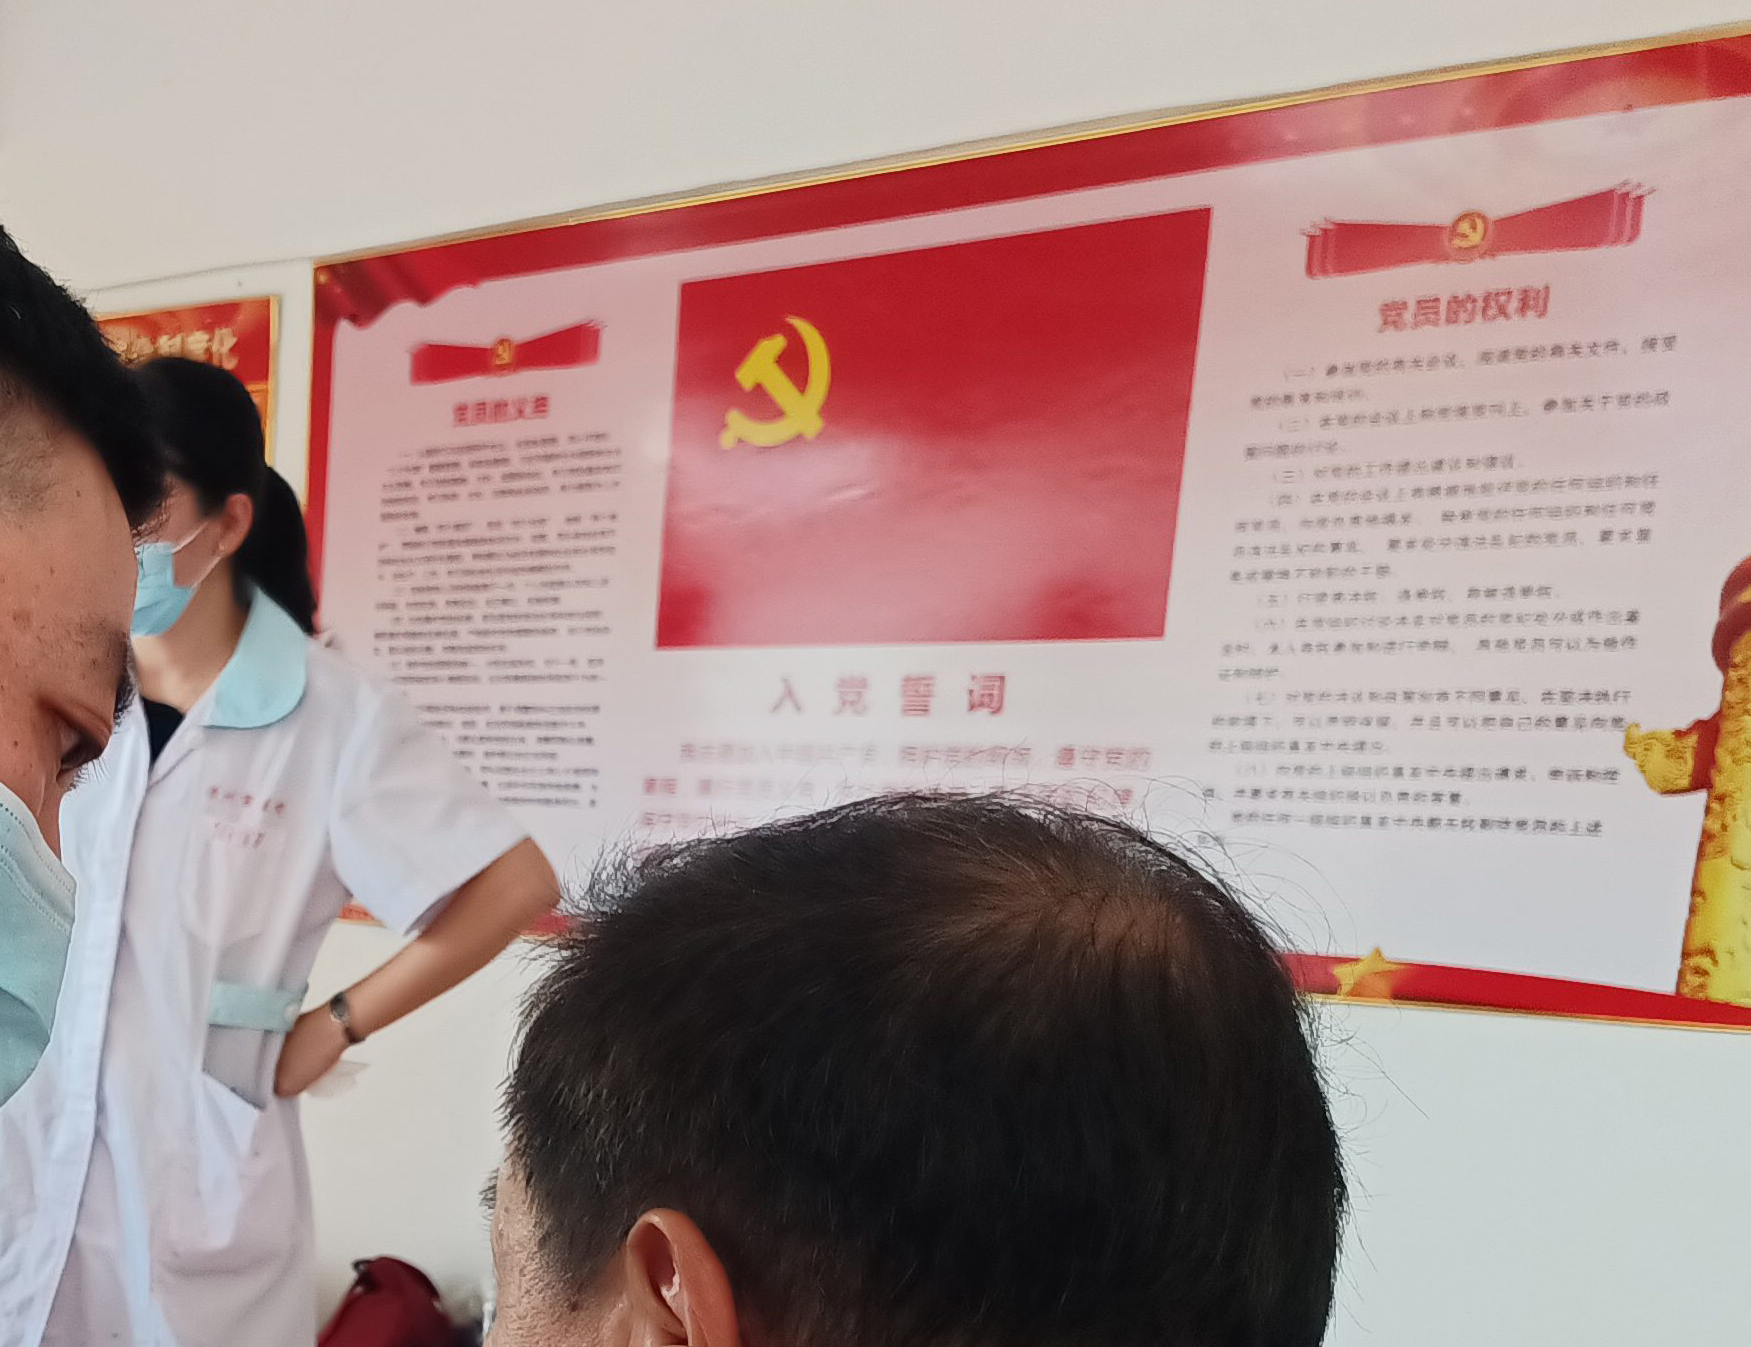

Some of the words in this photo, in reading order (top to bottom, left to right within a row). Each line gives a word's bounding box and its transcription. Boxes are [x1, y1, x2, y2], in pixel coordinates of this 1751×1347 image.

[1377, 285, 1551, 333] 党员的权利
[770, 673, 1007, 717] 入党誓词
